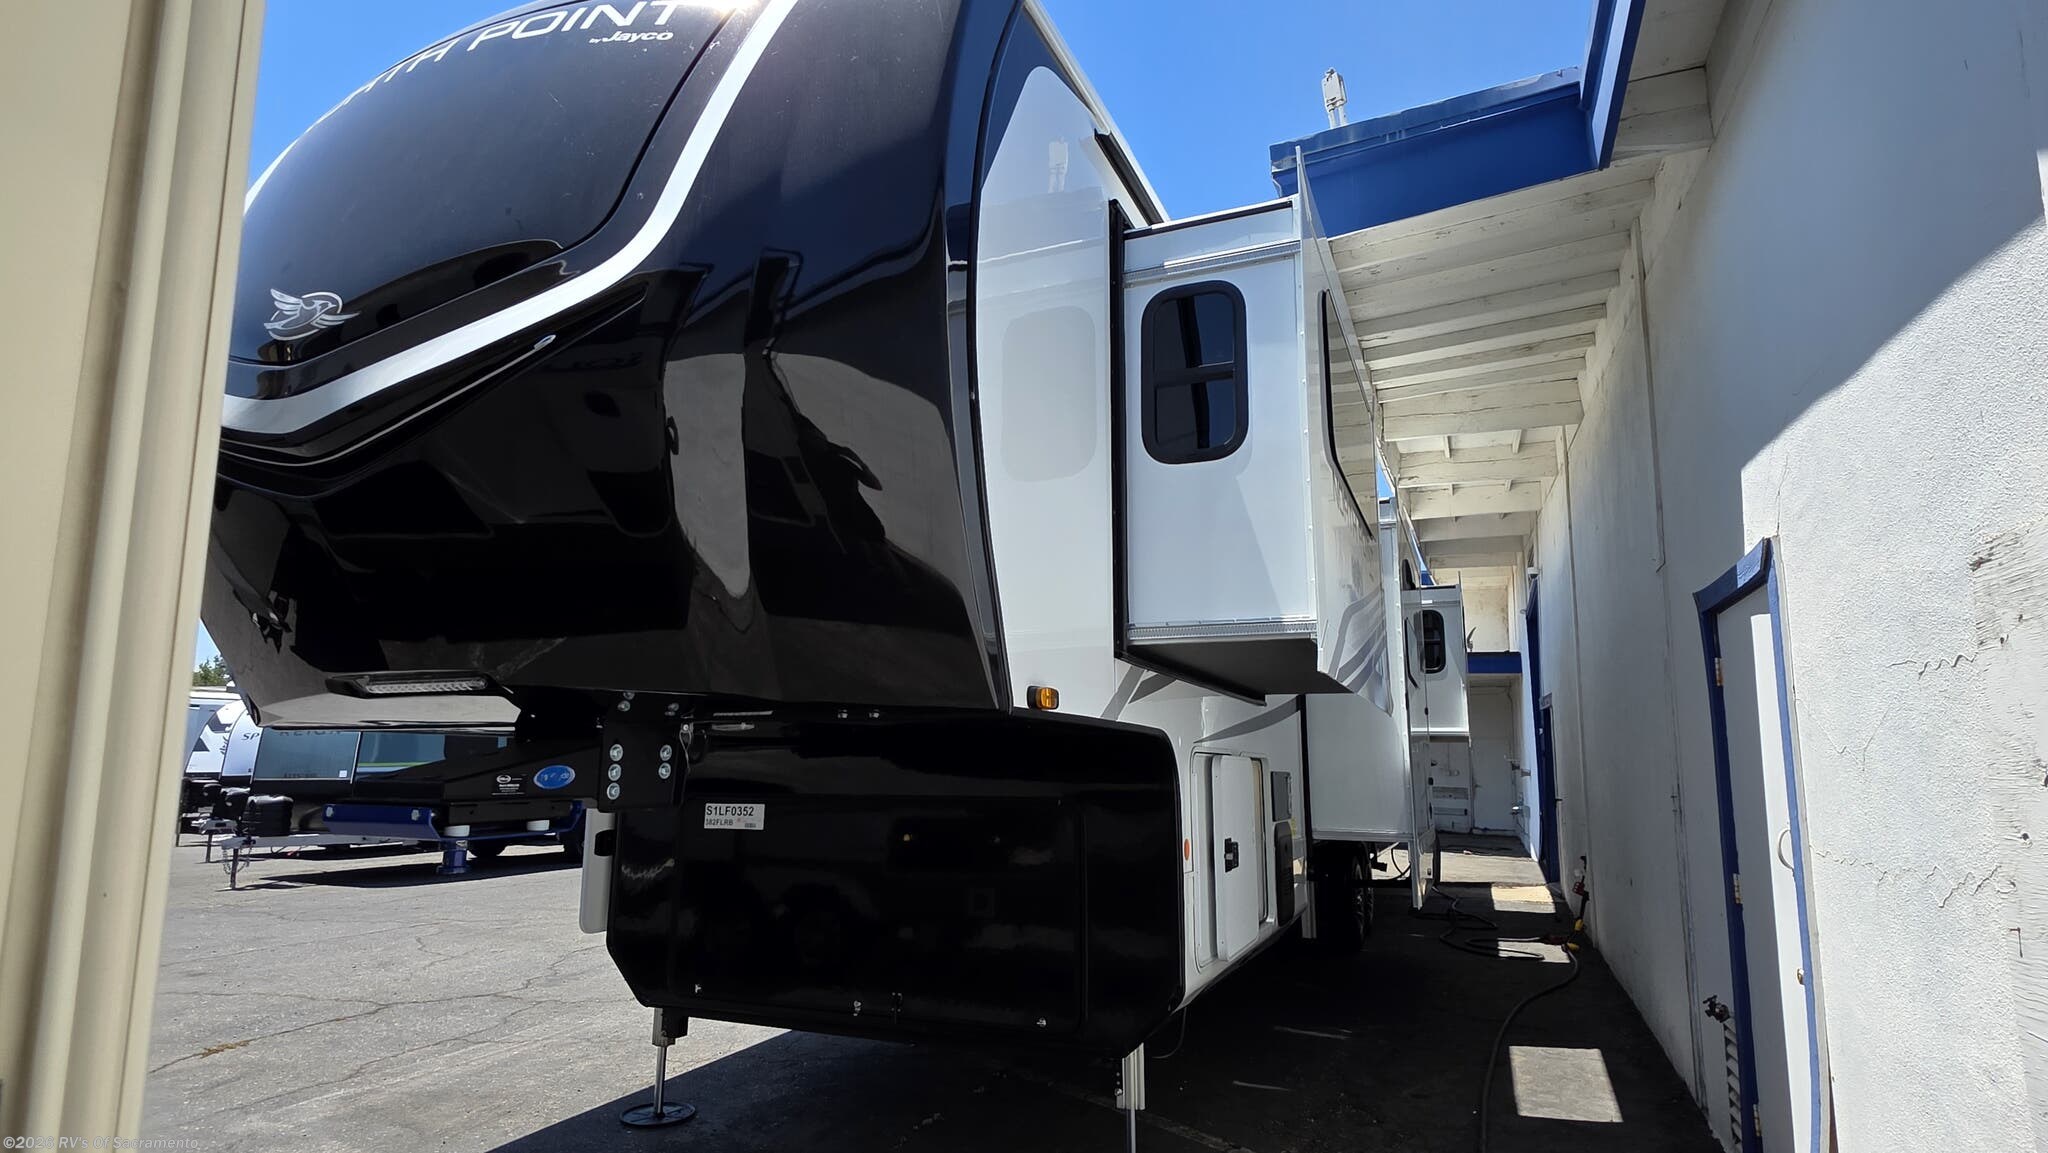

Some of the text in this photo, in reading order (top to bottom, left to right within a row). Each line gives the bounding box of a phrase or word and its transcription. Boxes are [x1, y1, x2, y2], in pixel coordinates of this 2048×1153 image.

[467, 1, 681, 51] POINT
[602, 31, 674, 43] Jayco
[706, 805, 754, 817] S1LF0352
